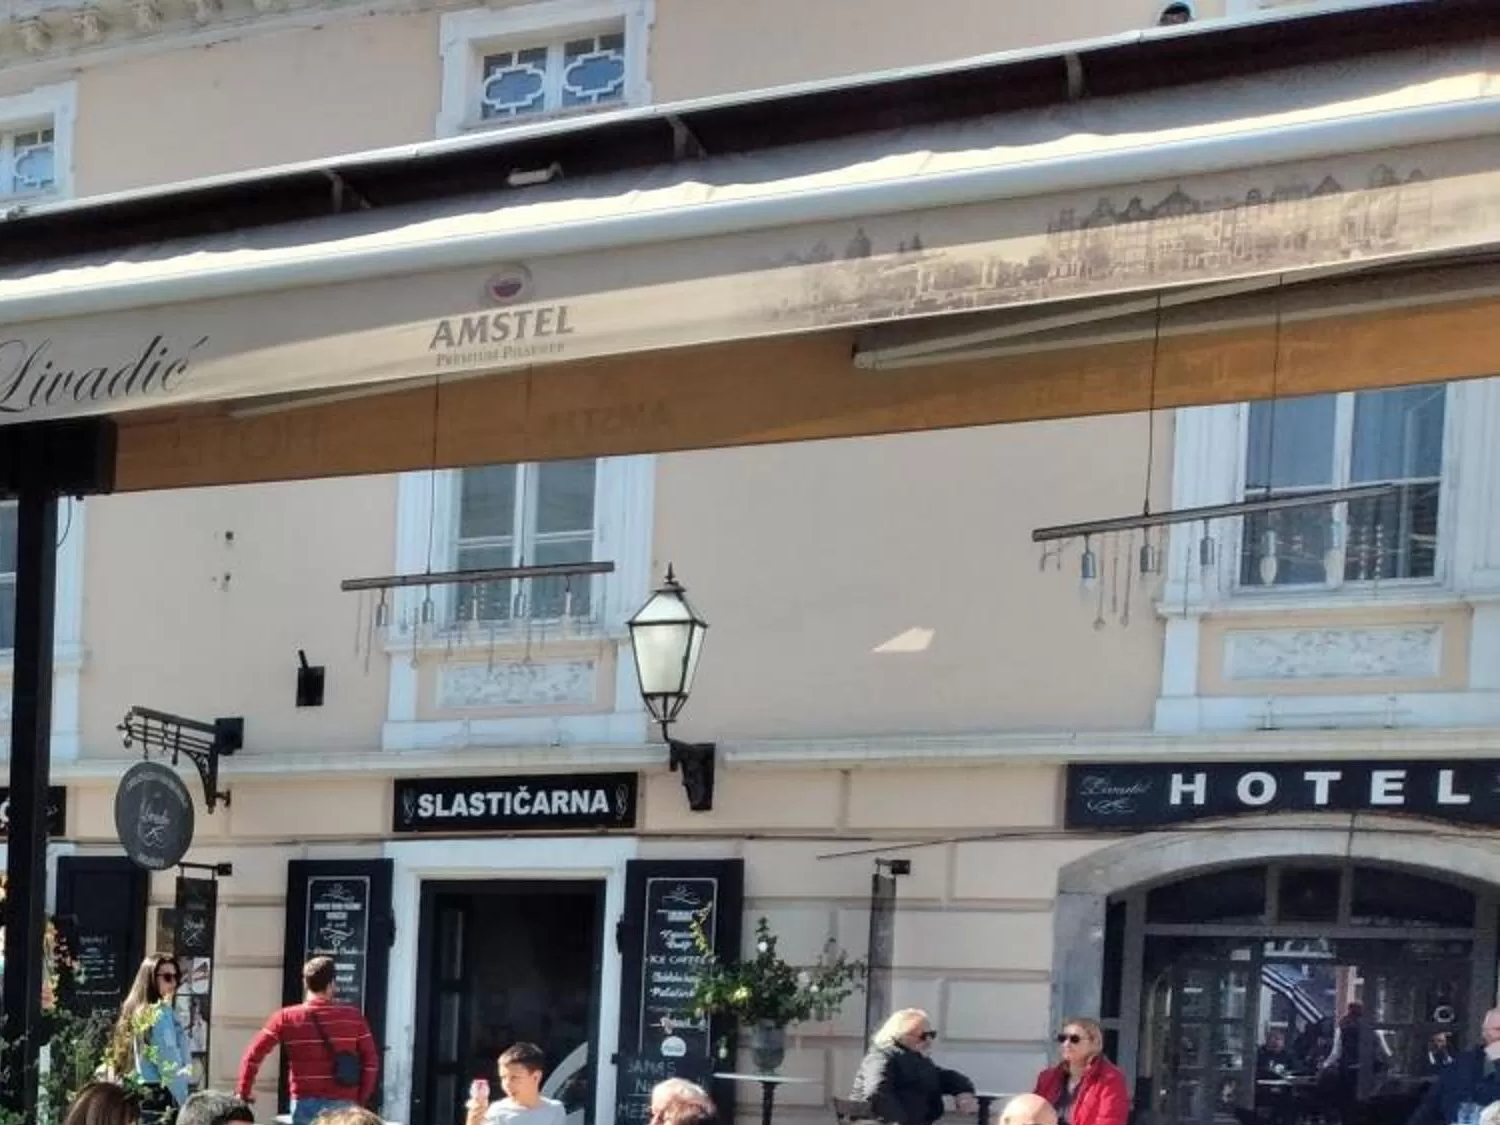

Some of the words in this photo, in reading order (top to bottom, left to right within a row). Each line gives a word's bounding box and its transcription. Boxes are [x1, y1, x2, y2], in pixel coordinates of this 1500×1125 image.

[429, 305, 575, 350] AMSTEL
[417, 785, 609, 817] SLASTIČARNA
[1169, 769, 1471, 806] HOTEL
